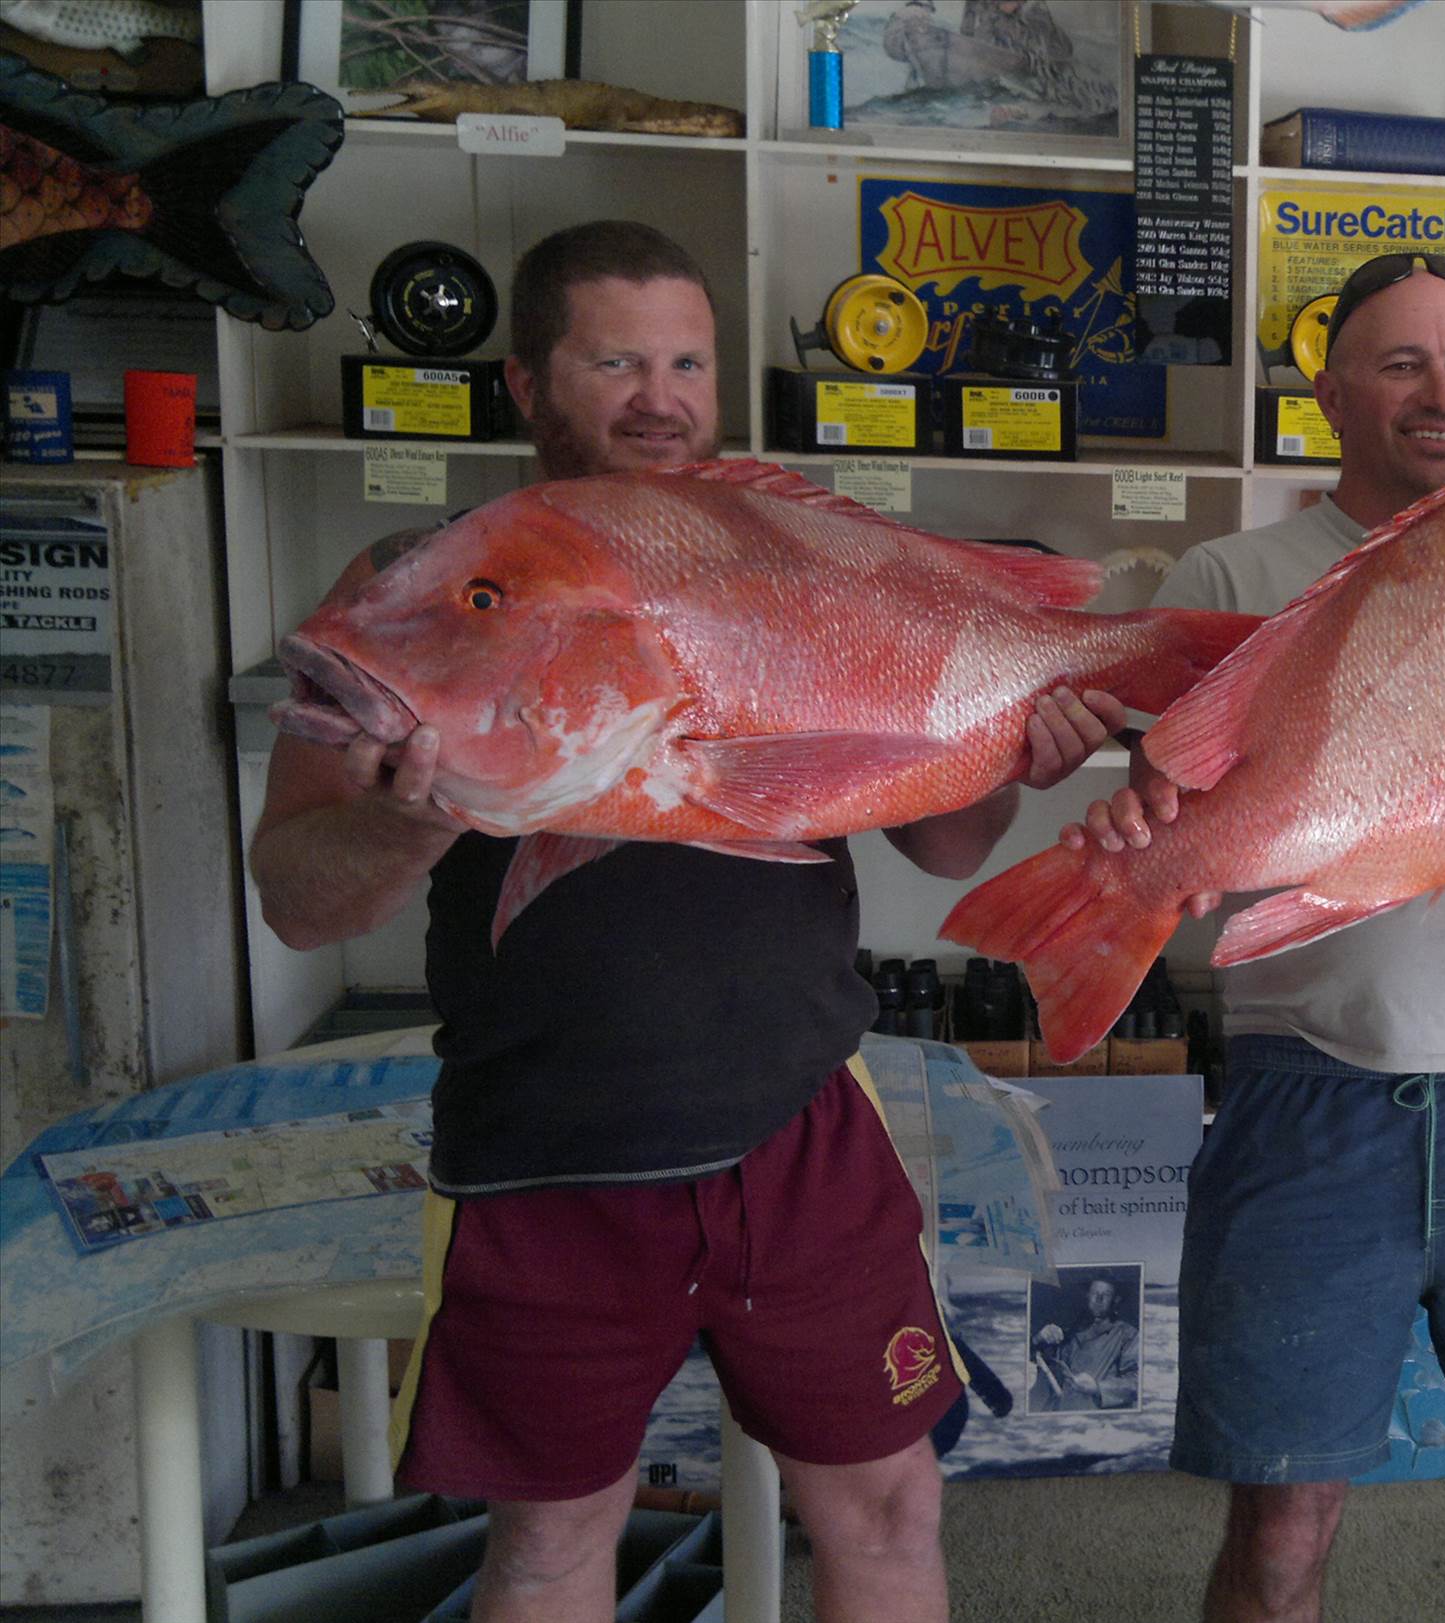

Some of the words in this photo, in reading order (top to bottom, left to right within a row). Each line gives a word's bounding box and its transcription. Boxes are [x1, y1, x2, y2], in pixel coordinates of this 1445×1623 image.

[1182, 62, 1217, 77] Design
[1140, 77, 1177, 86] SNAPPER
[1179, 78, 1227, 87] CHAMPIONS
[913, 208, 1059, 271] ALVEY
[1273, 240, 1298, 250] BLUE
[1303, 241, 1339, 251] WATER
[1342, 243, 1379, 252] SERIES
[1383, 244, 1429, 254] SPINNING
[925, 300, 1083, 321] perior
[423, 371, 458, 382] 600A5
[1015, 391, 1046, 400] 600B
[1135, 471, 1152, 483] Light
[1153, 472, 1168, 481] Surf
[0, 538, 109, 568] SIGN
[0, 570, 33, 582] LITY
[0, 586, 52, 599] SHING
[59, 587, 110, 600] RODS
[15, 616, 95, 631] TACKLE
[1059, 1197, 1080, 1215] of
[1083, 1197, 1117, 1215] bait
[1120, 1196, 1188, 1216] spinnin
